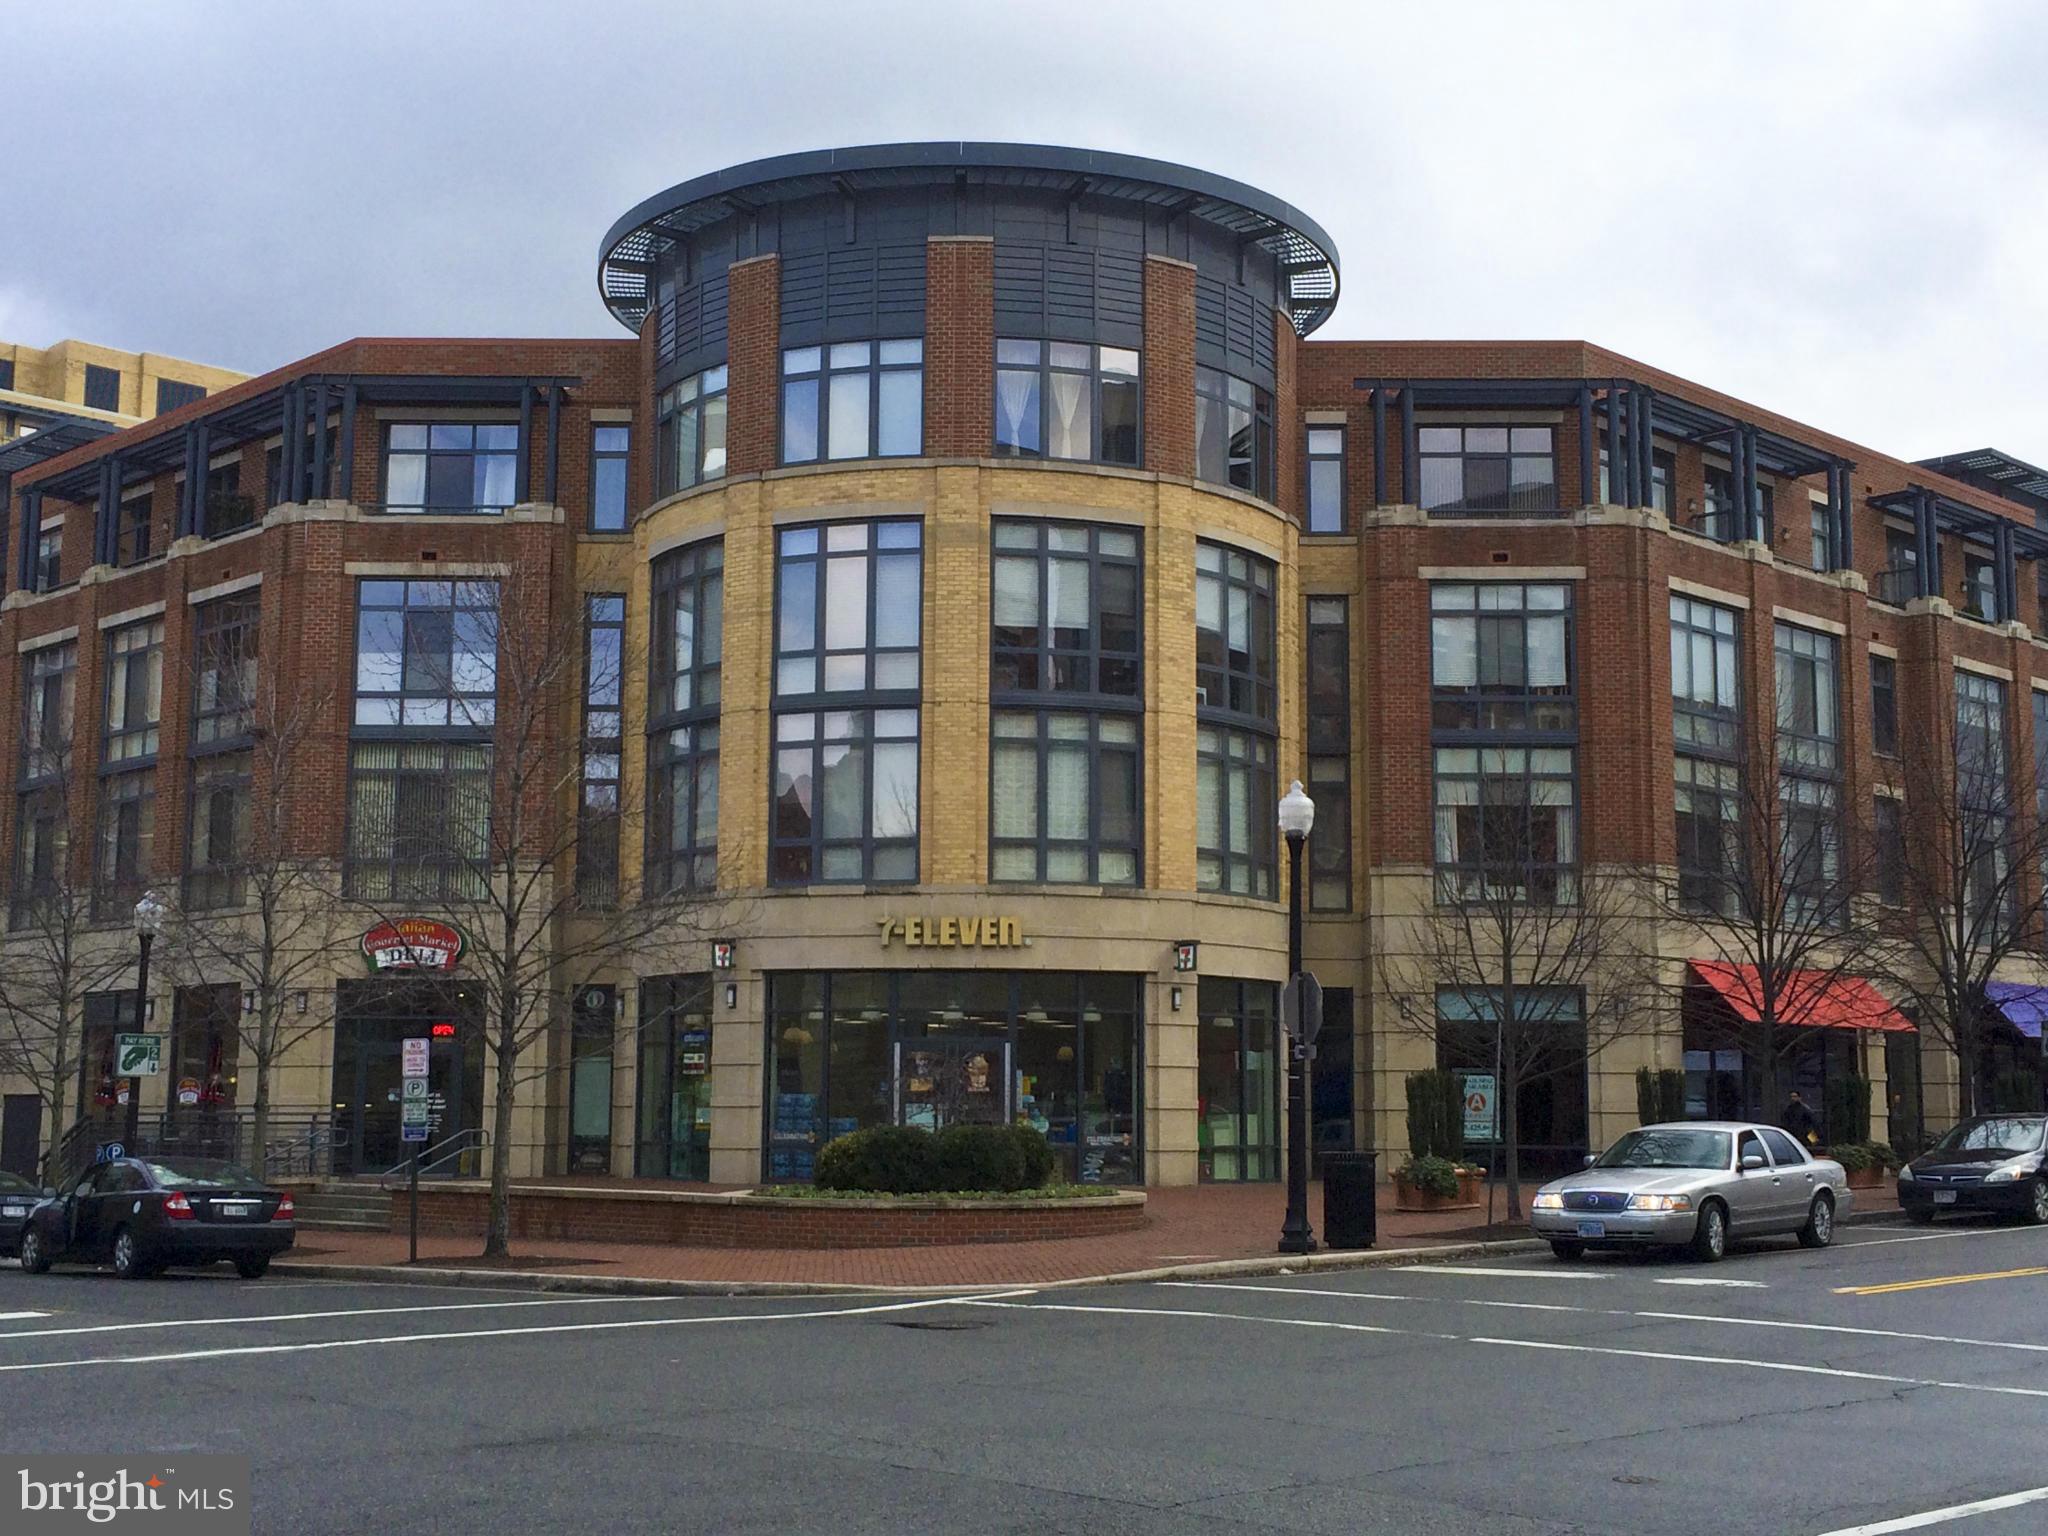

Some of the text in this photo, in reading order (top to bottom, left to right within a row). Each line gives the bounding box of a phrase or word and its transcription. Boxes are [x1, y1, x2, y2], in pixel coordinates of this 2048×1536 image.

[419, 934, 457, 949] Market
[432, 1024, 455, 1035] OPEN
[410, 1041, 422, 1049] NO
[150, 1047, 159, 1058] 2
[112, 1146, 121, 1160] P
